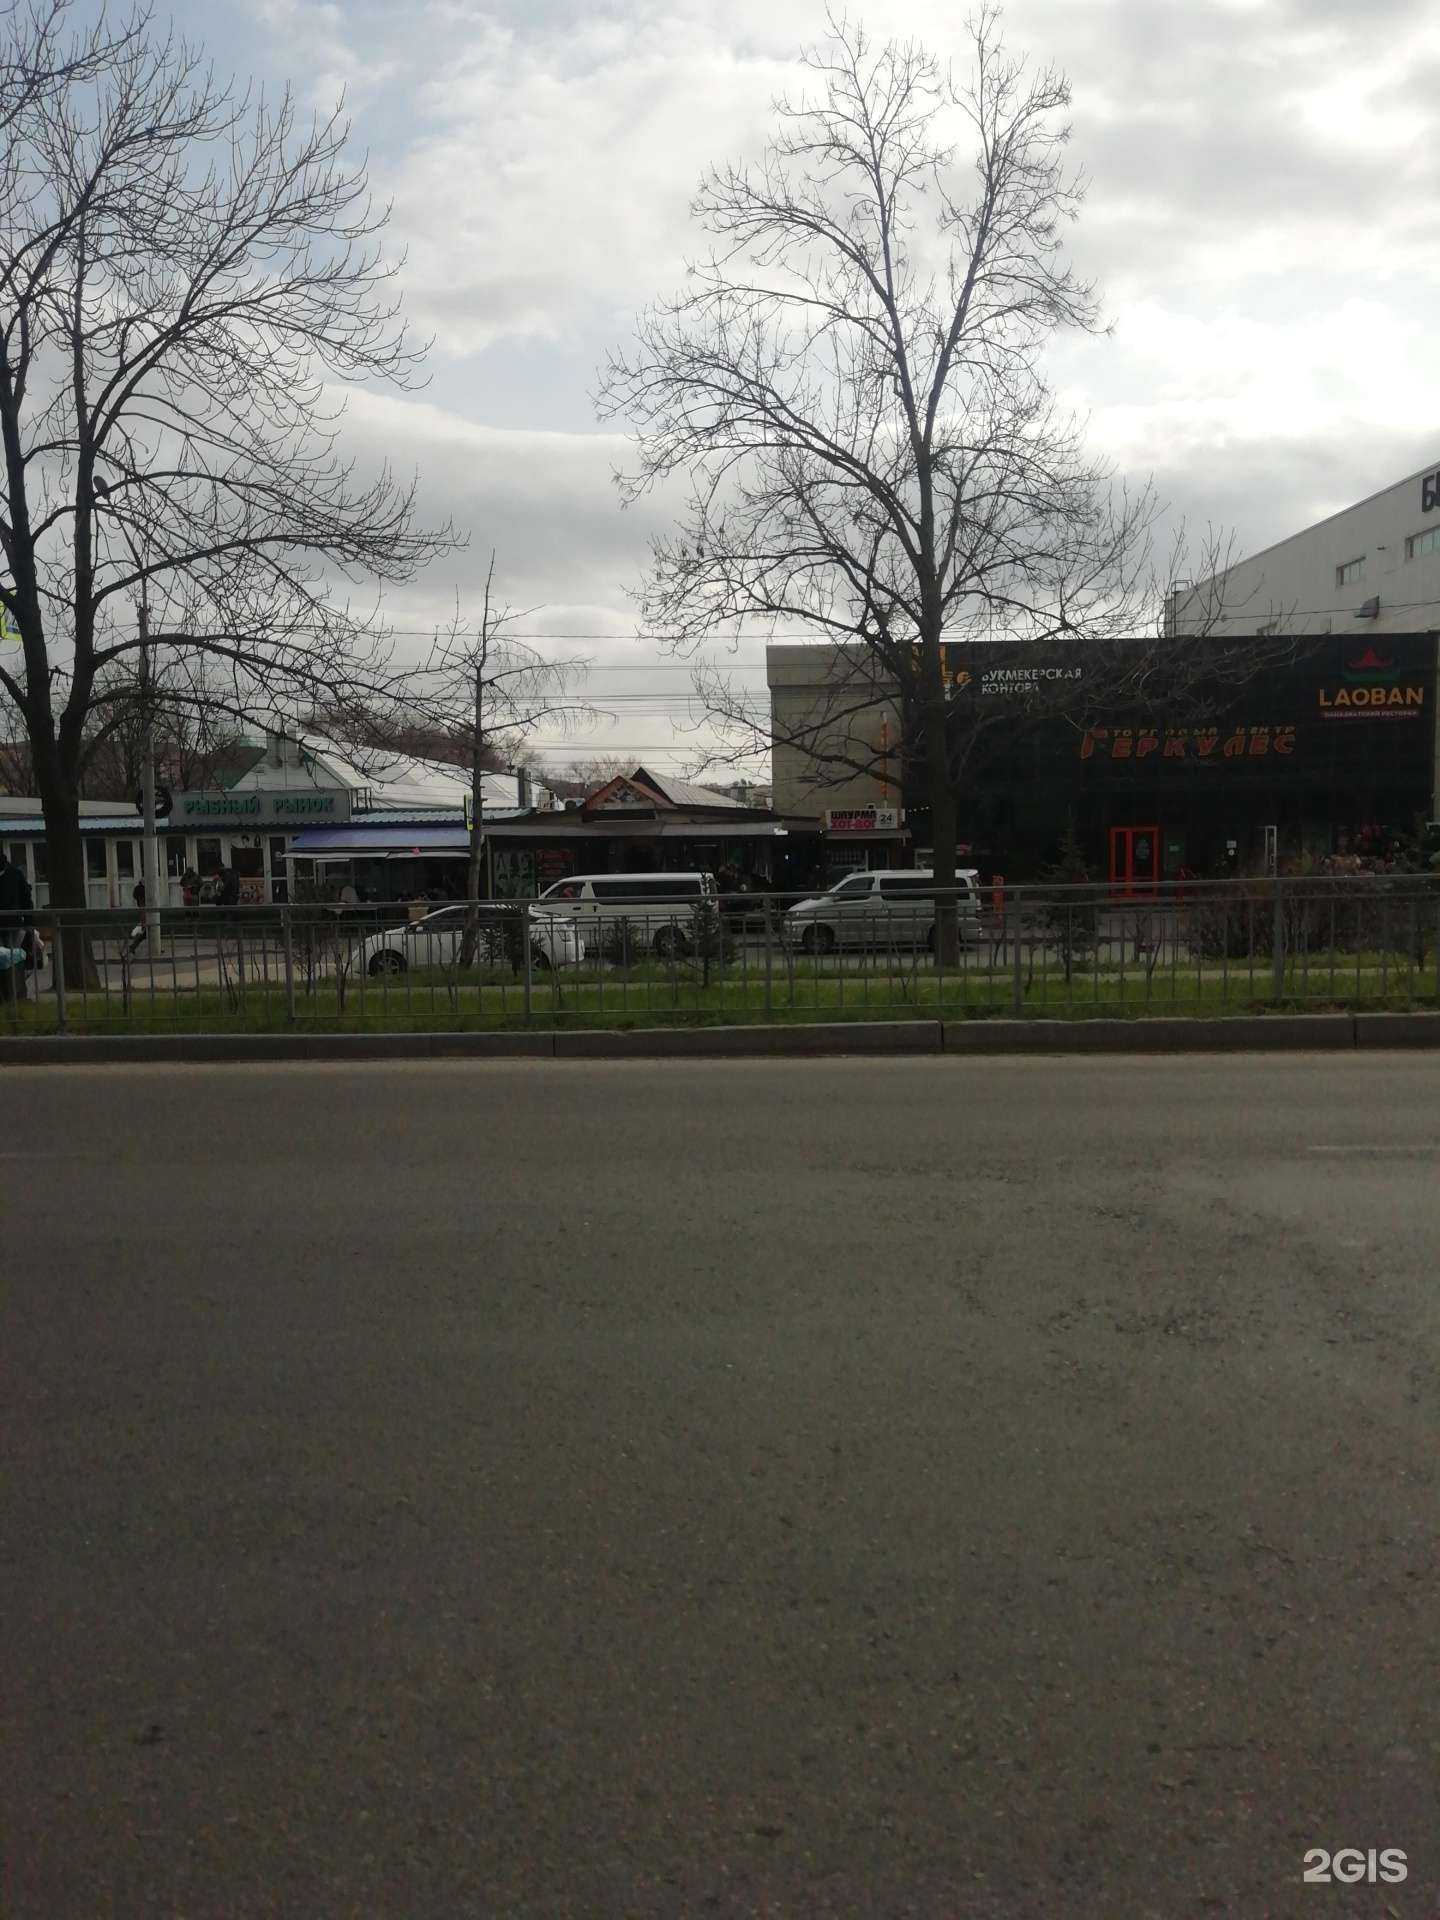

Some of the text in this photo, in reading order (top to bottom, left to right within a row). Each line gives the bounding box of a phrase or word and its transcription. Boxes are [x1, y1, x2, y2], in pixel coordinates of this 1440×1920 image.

[1319, 687, 1424, 706] LAOBAN
[183, 796, 335, 815] РЫБНЫЙ РЫНОК
